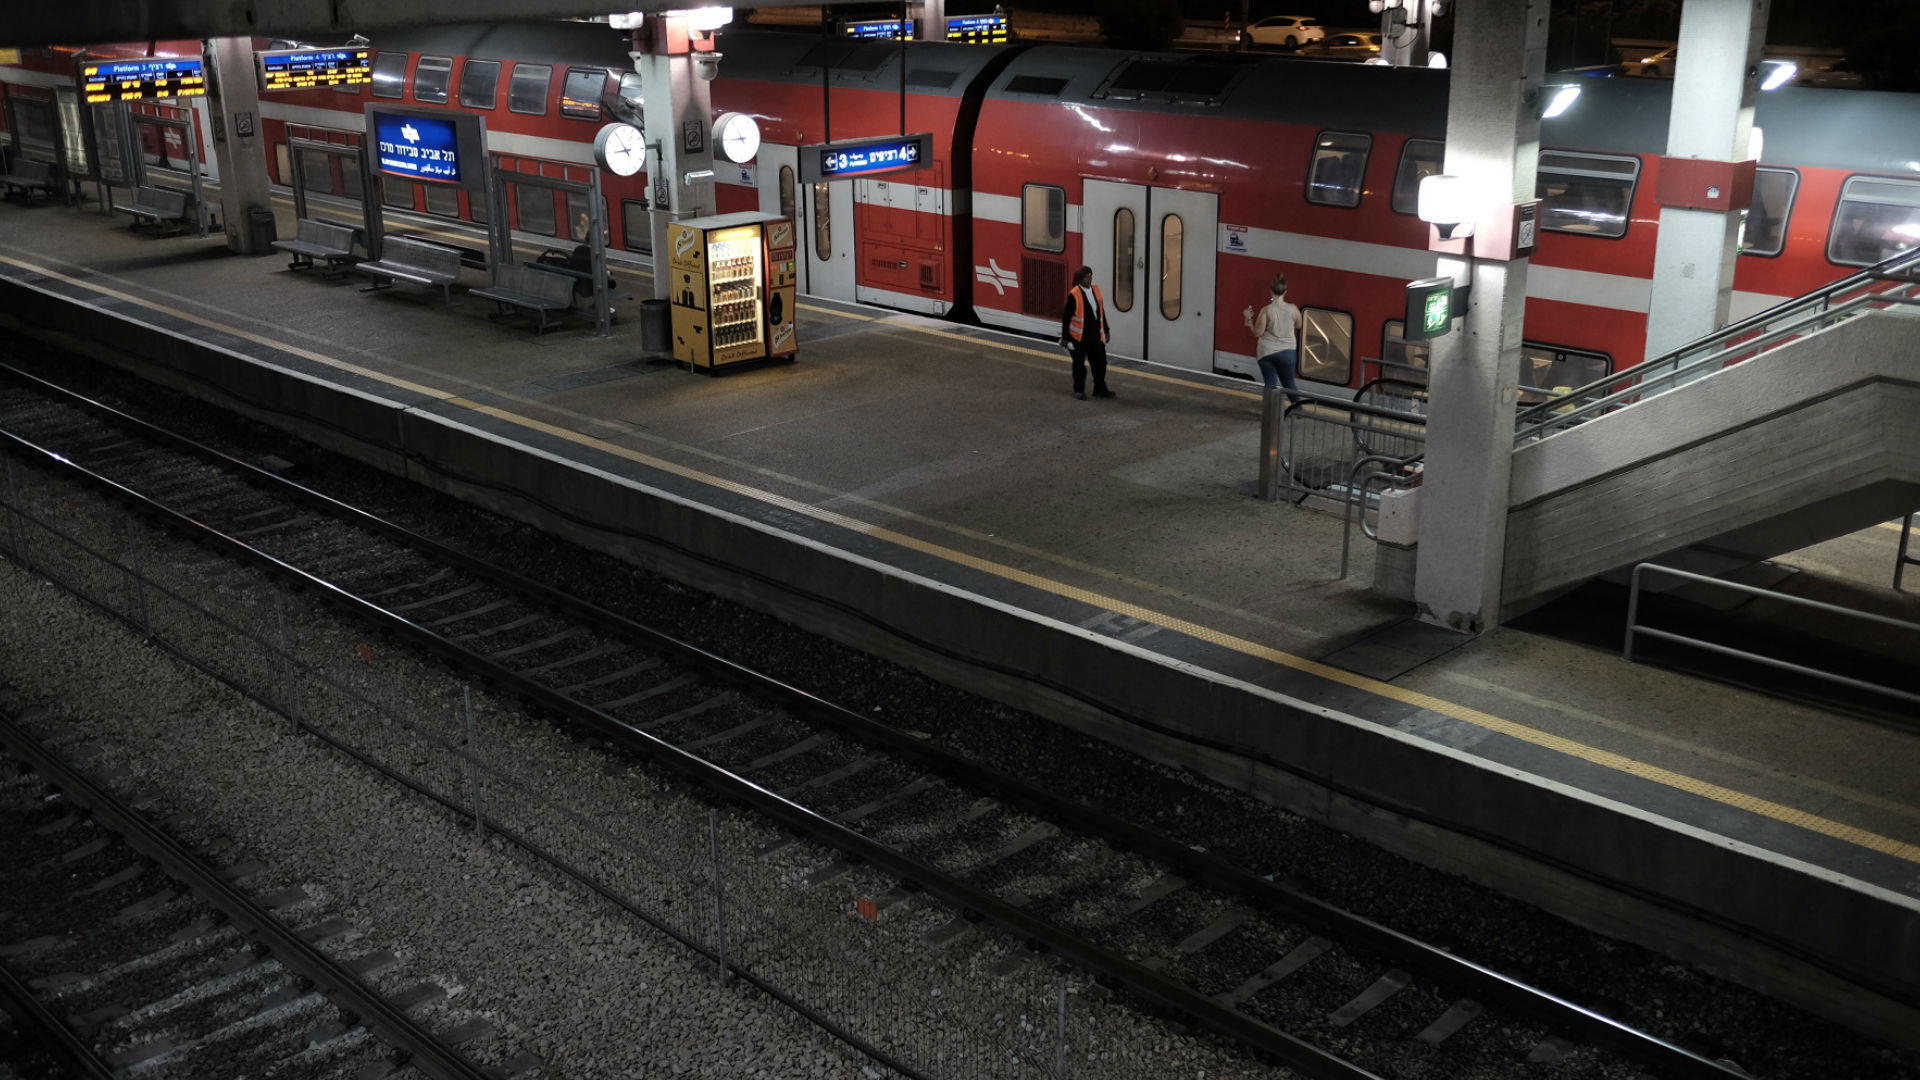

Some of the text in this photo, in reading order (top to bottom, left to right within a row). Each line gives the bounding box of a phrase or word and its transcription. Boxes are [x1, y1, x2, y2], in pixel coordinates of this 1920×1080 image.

[113, 64, 139, 72] Platform
[379, 141, 456, 162] תל אביב סבידור מרכז
[869, 146, 907, 163] רציפים 4
[838, 153, 848, 169] 3
